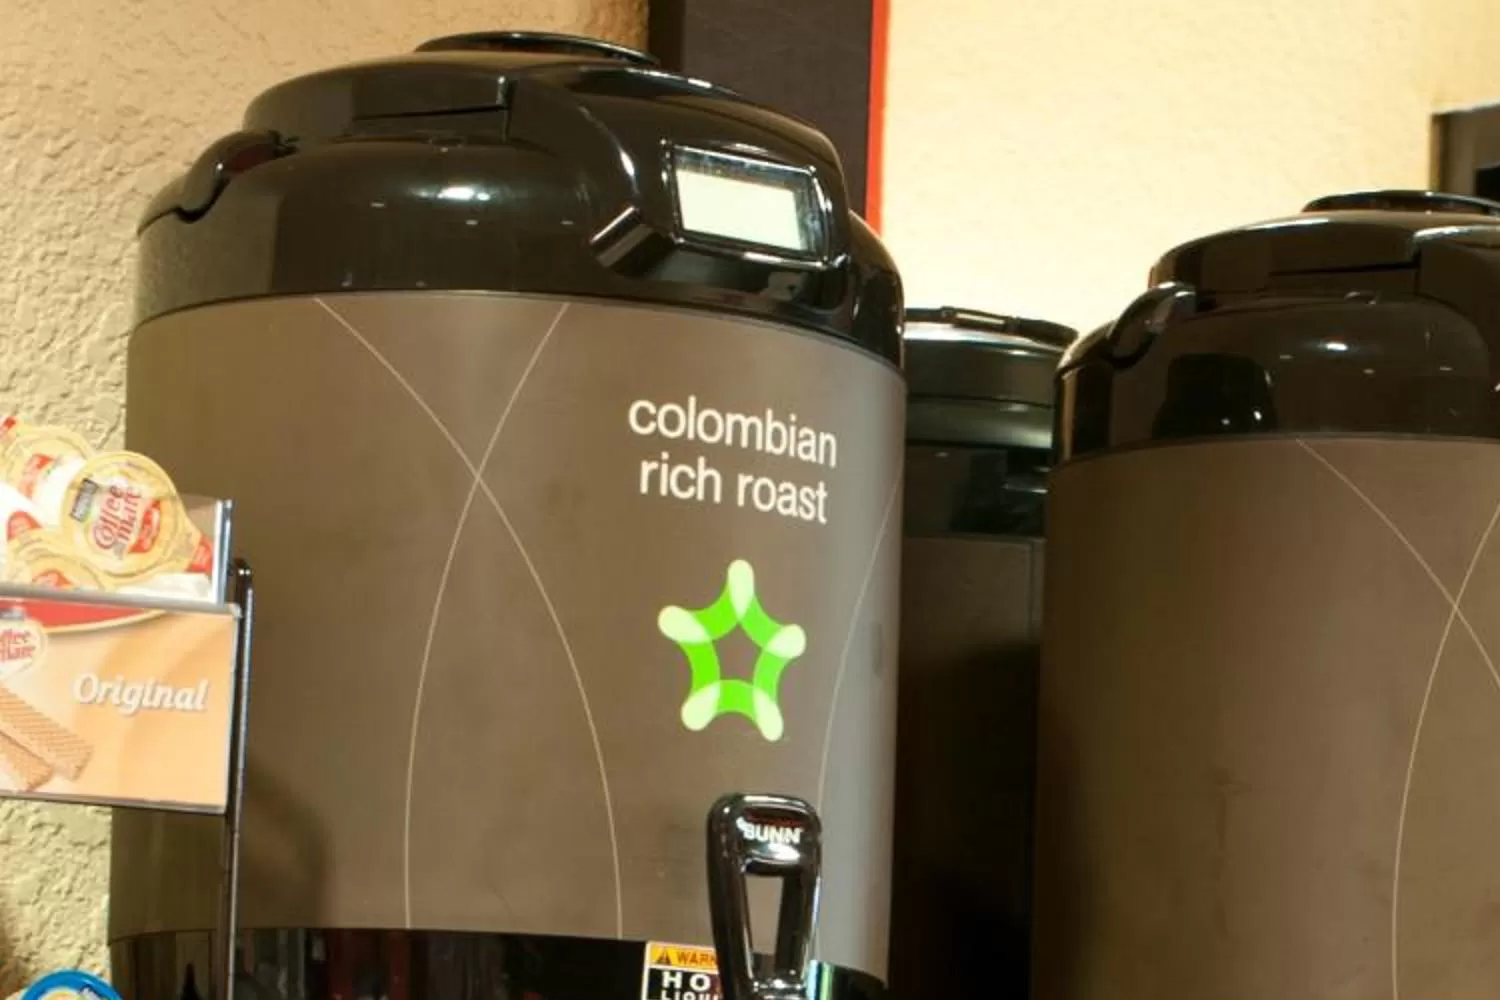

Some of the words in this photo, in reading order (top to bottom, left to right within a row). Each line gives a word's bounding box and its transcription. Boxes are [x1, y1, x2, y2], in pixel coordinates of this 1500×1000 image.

[628, 394, 838, 469] colombian
[639, 451, 723, 504] rich
[737, 473, 828, 525] roast
[73, 674, 209, 714] Original
[741, 822, 802, 843] BUNN
[662, 970, 712, 992] HO
